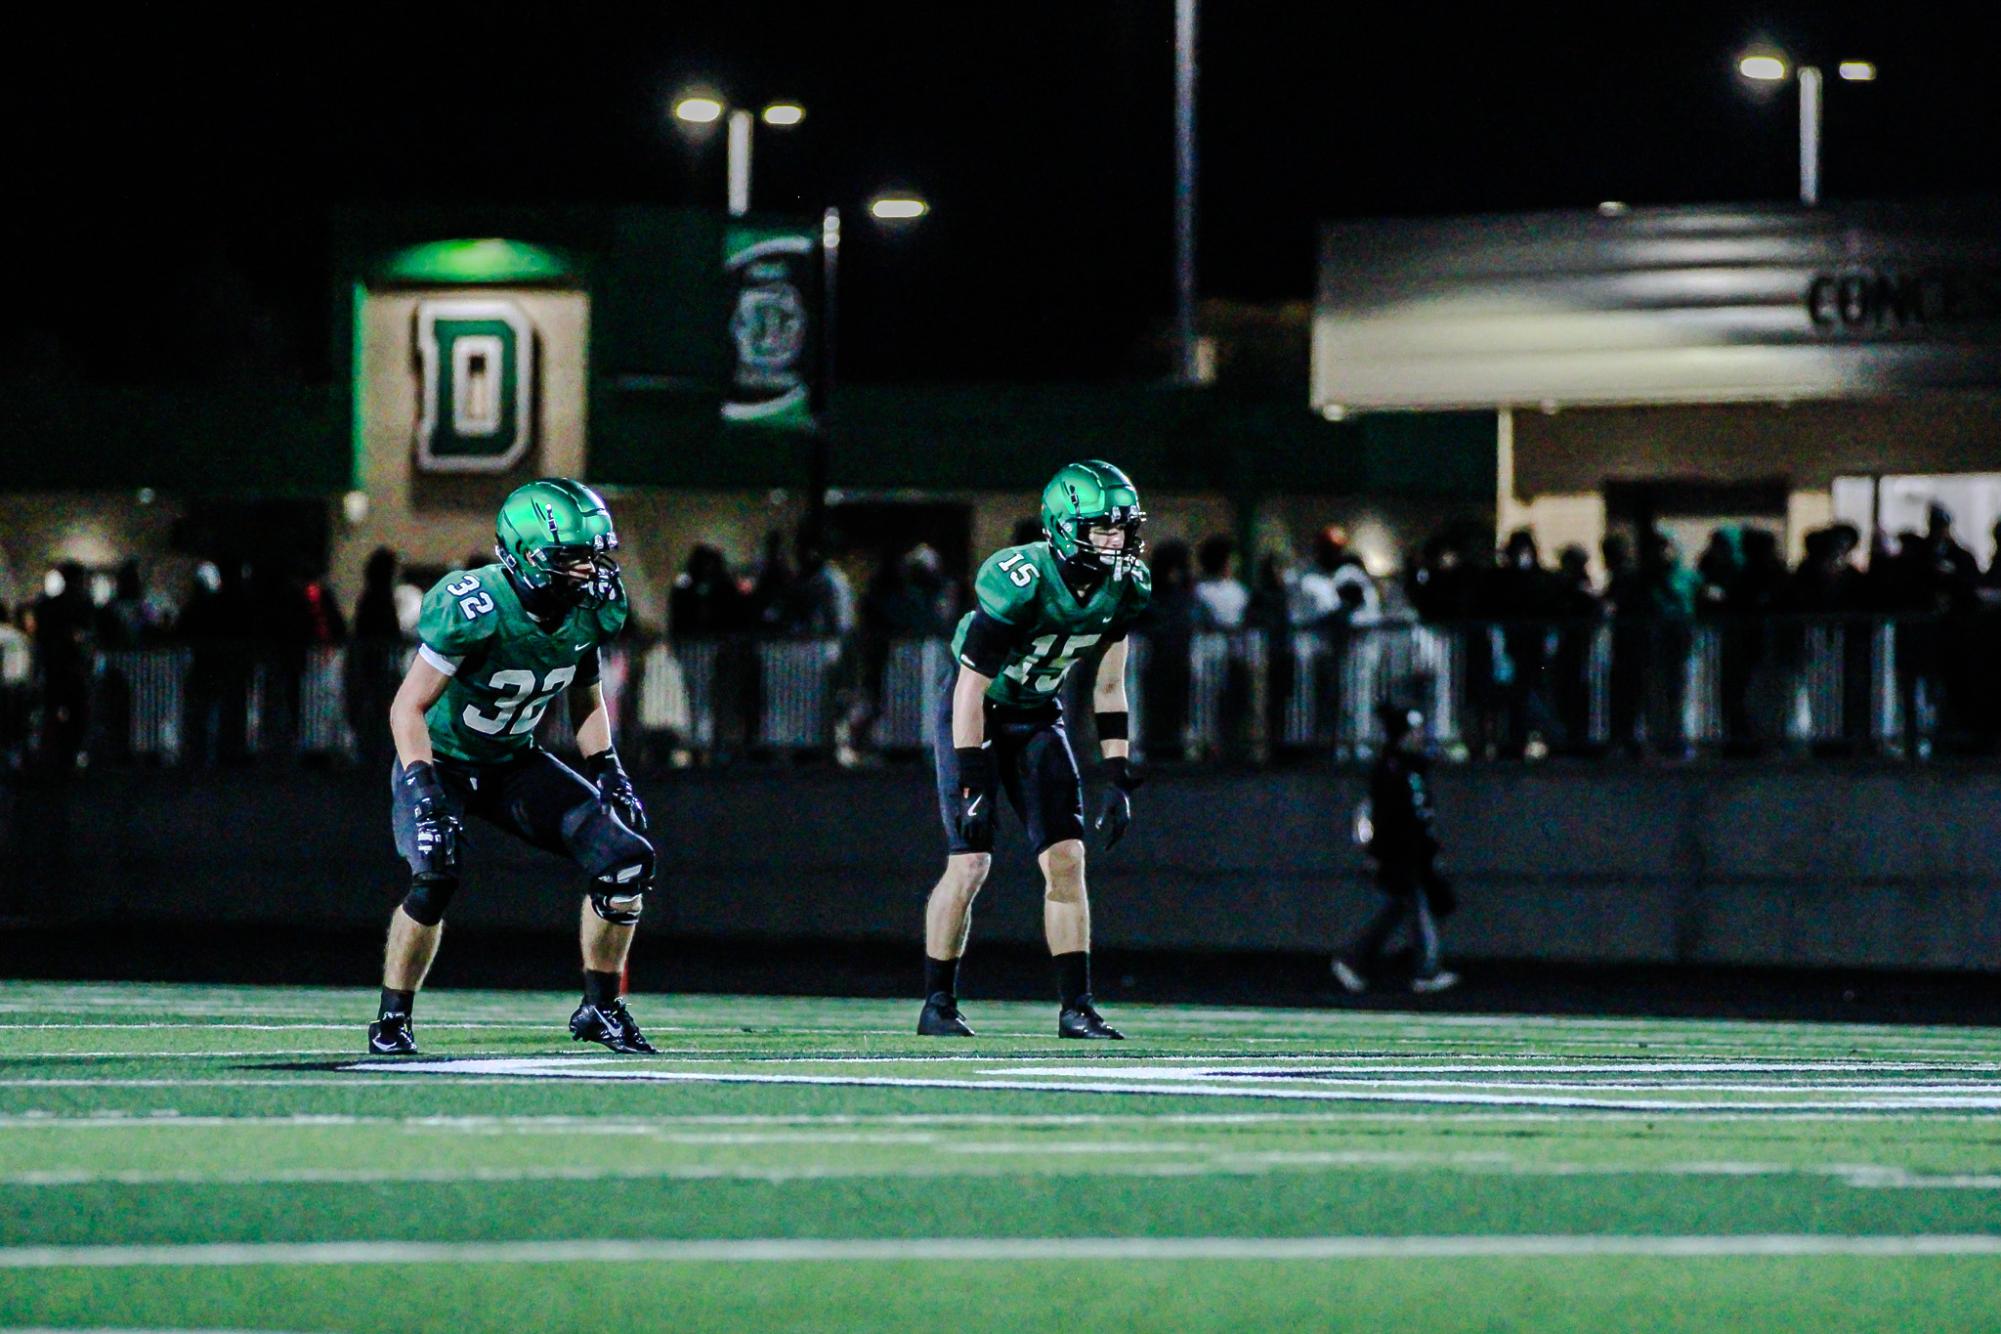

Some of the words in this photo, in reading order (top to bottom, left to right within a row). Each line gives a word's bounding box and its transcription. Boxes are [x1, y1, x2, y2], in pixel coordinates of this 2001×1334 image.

[998, 552, 1040, 588] 15
[446, 574, 495, 621] 32
[1002, 633, 1102, 692] 15
[462, 664, 577, 736] 32
